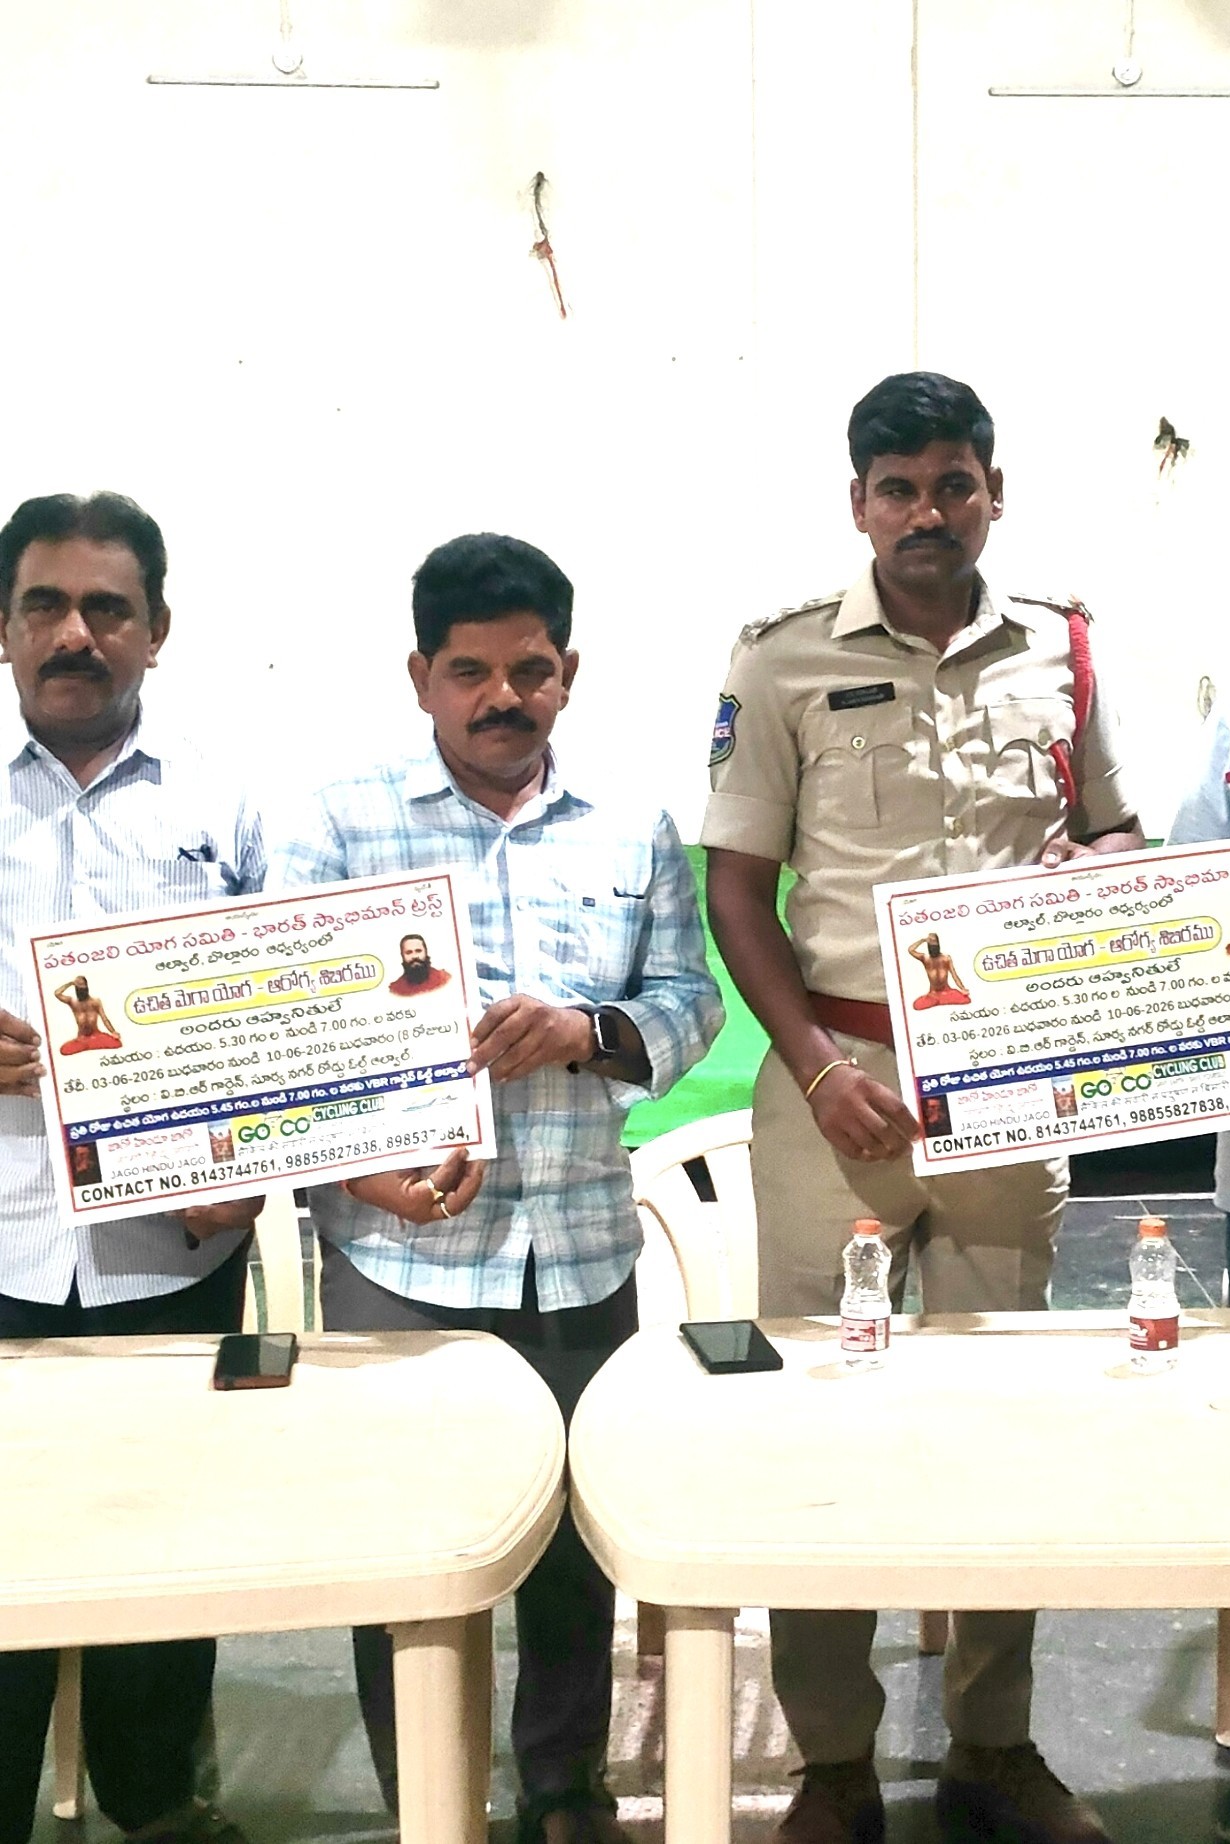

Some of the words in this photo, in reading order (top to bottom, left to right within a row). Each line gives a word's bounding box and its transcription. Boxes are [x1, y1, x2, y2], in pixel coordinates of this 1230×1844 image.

[898, 904, 970, 925] పతంజలి
[975, 895, 1024, 914] యోగ
[1028, 888, 1080, 907] సమితి
[1096, 875, 1148, 899] భారత్
[43, 945, 120, 969] పతంజలి
[125, 935, 177, 956] యోగ
[182, 927, 235, 948] సమితి
[252, 913, 306, 939] భారత్
[312, 898, 405, 931] స్వాభిమాన్
[410, 893, 442, 917] ట్రస్ట్
[1153, 1060, 1198, 1078] CYCLING
[1198, 1055, 1225, 1069] CLUB
[313, 1101, 358, 1121] CYCLING
[932, 1131, 1000, 1153] CONTACT
[1005, 1127, 1031, 1143] NO.
[1035, 1113, 1126, 1138] 8143744761,
[1129, 1096, 1229, 1123] 98855827838,
[80, 1178, 153, 1202] CONTACT
[158, 1174, 186, 1190] NO.
[190, 1158, 281, 1185] 8143744761,
[285, 1139, 381, 1168] 98855827838,
